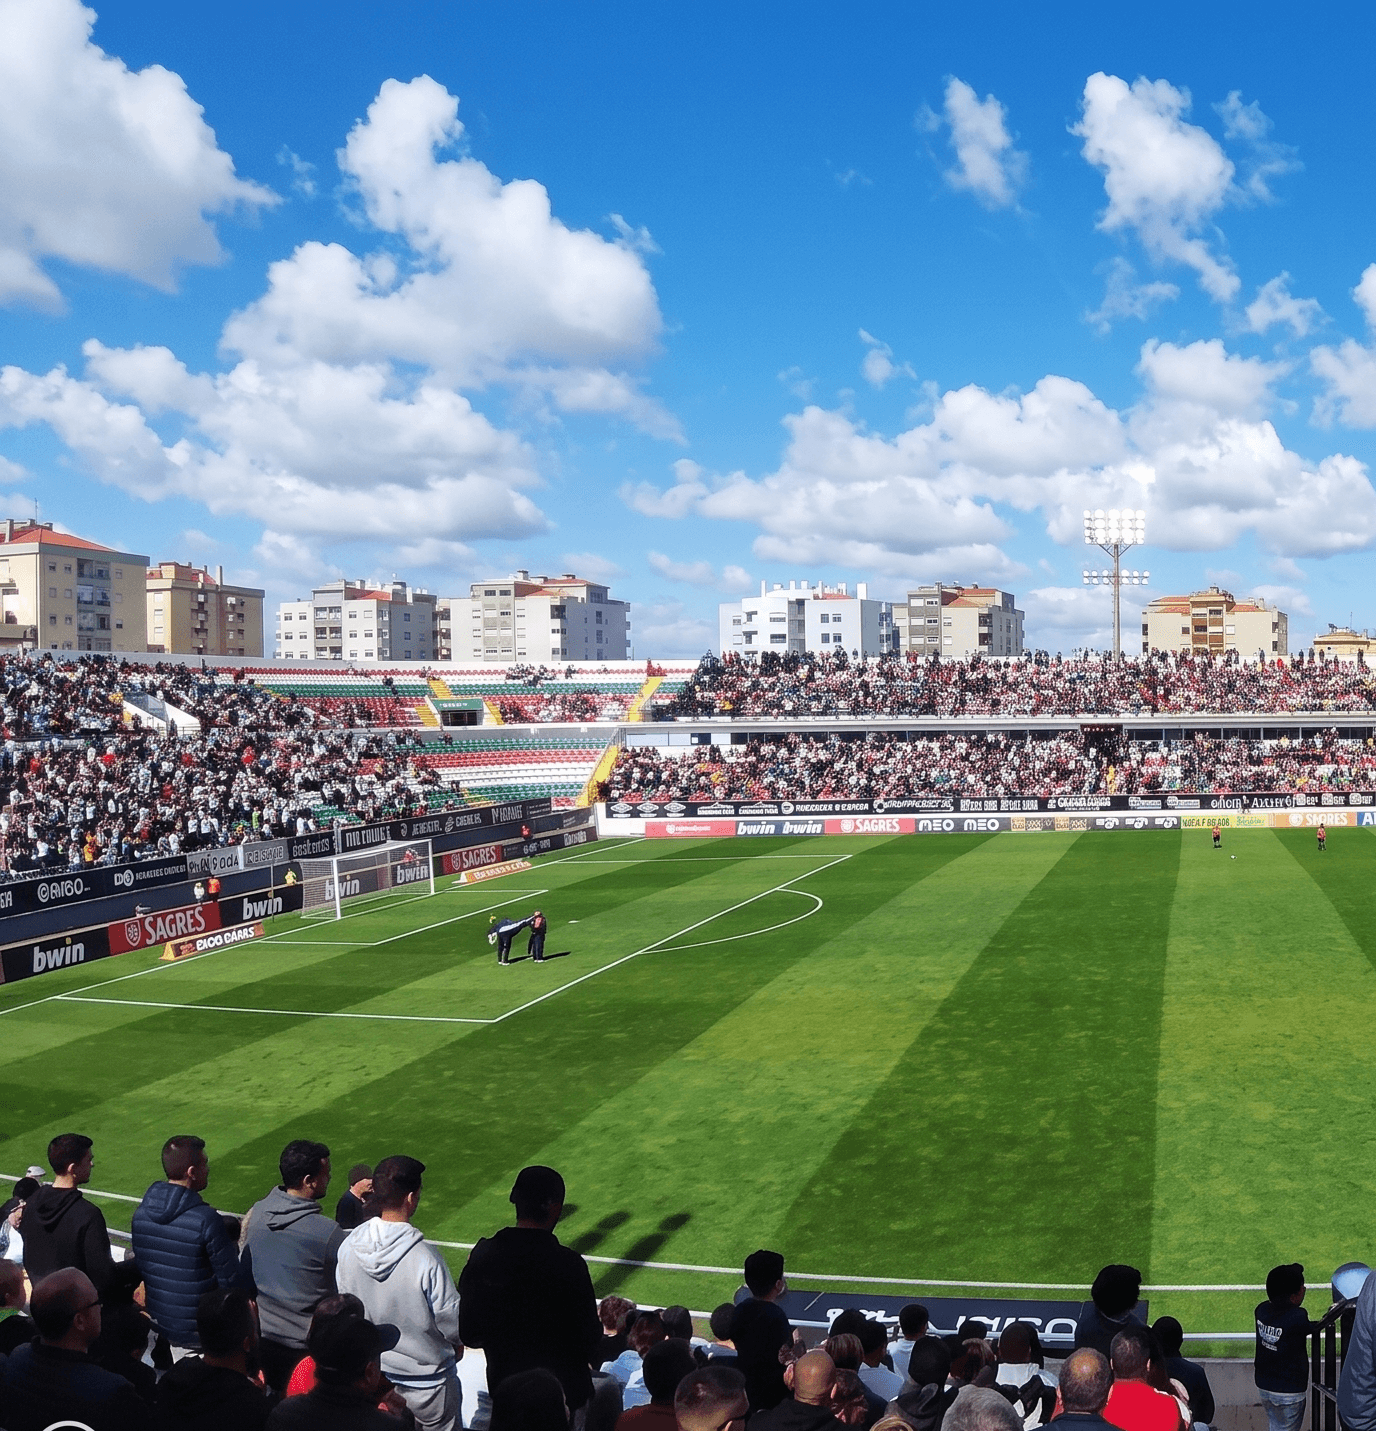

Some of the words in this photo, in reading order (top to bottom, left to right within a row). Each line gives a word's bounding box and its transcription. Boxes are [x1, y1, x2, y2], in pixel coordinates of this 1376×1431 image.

[737, 821, 776, 835] bwin
[782, 820, 822, 834] bwin
[855, 818, 900, 832] SAGRES
[919, 819, 954, 831] MEO
[964, 818, 999, 830] MEO
[243, 891, 283, 921] bwin
[144, 906, 206, 945] SAGRES
[33, 937, 84, 973] bwin
